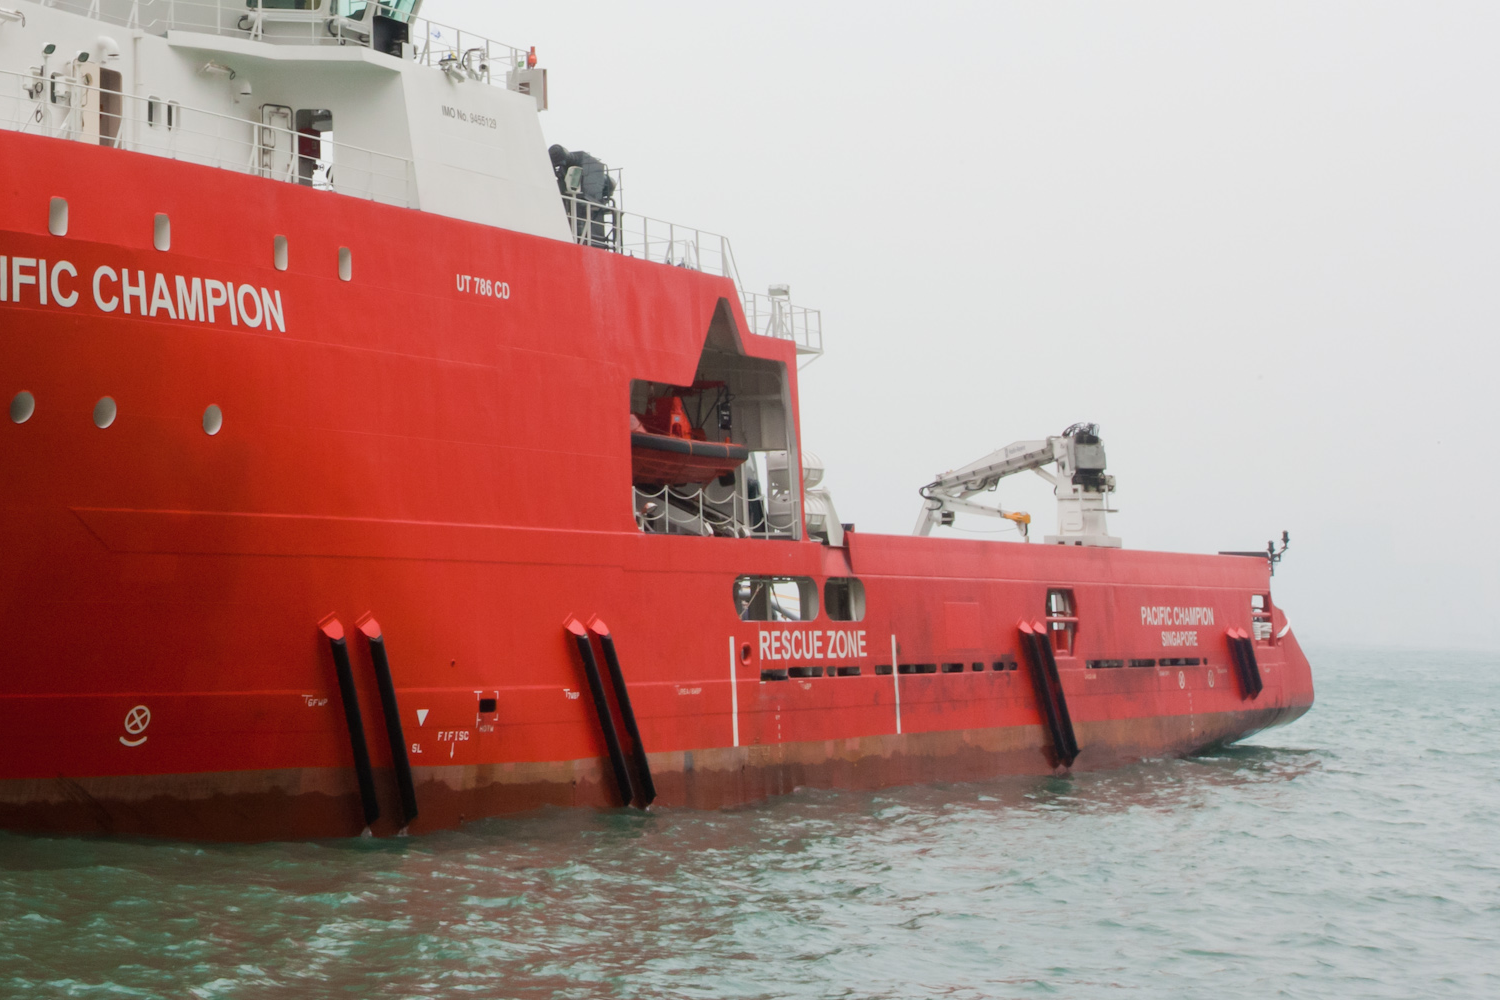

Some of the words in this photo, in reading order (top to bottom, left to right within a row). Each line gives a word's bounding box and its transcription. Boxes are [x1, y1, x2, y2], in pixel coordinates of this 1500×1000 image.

[441, 104, 456, 119] IMO
[456, 108, 469, 122] No.
[469, 112, 497, 129] 9455129
[456, 273, 472, 293] UT
[473, 276, 493, 297] 786
[494, 280, 511, 300] CD
[92, 265, 286, 332] CHAMPION
[1140, 606, 1173, 626] PACIFIC
[1173, 606, 1215, 626] CHAMPION
[759, 630, 824, 660] RESCUE
[826, 630, 867, 659] ZONE
[1161, 630, 1199, 647] SINGAPORE
[437, 731, 469, 741] FIFISC
[411, 743, 423, 753] SL
